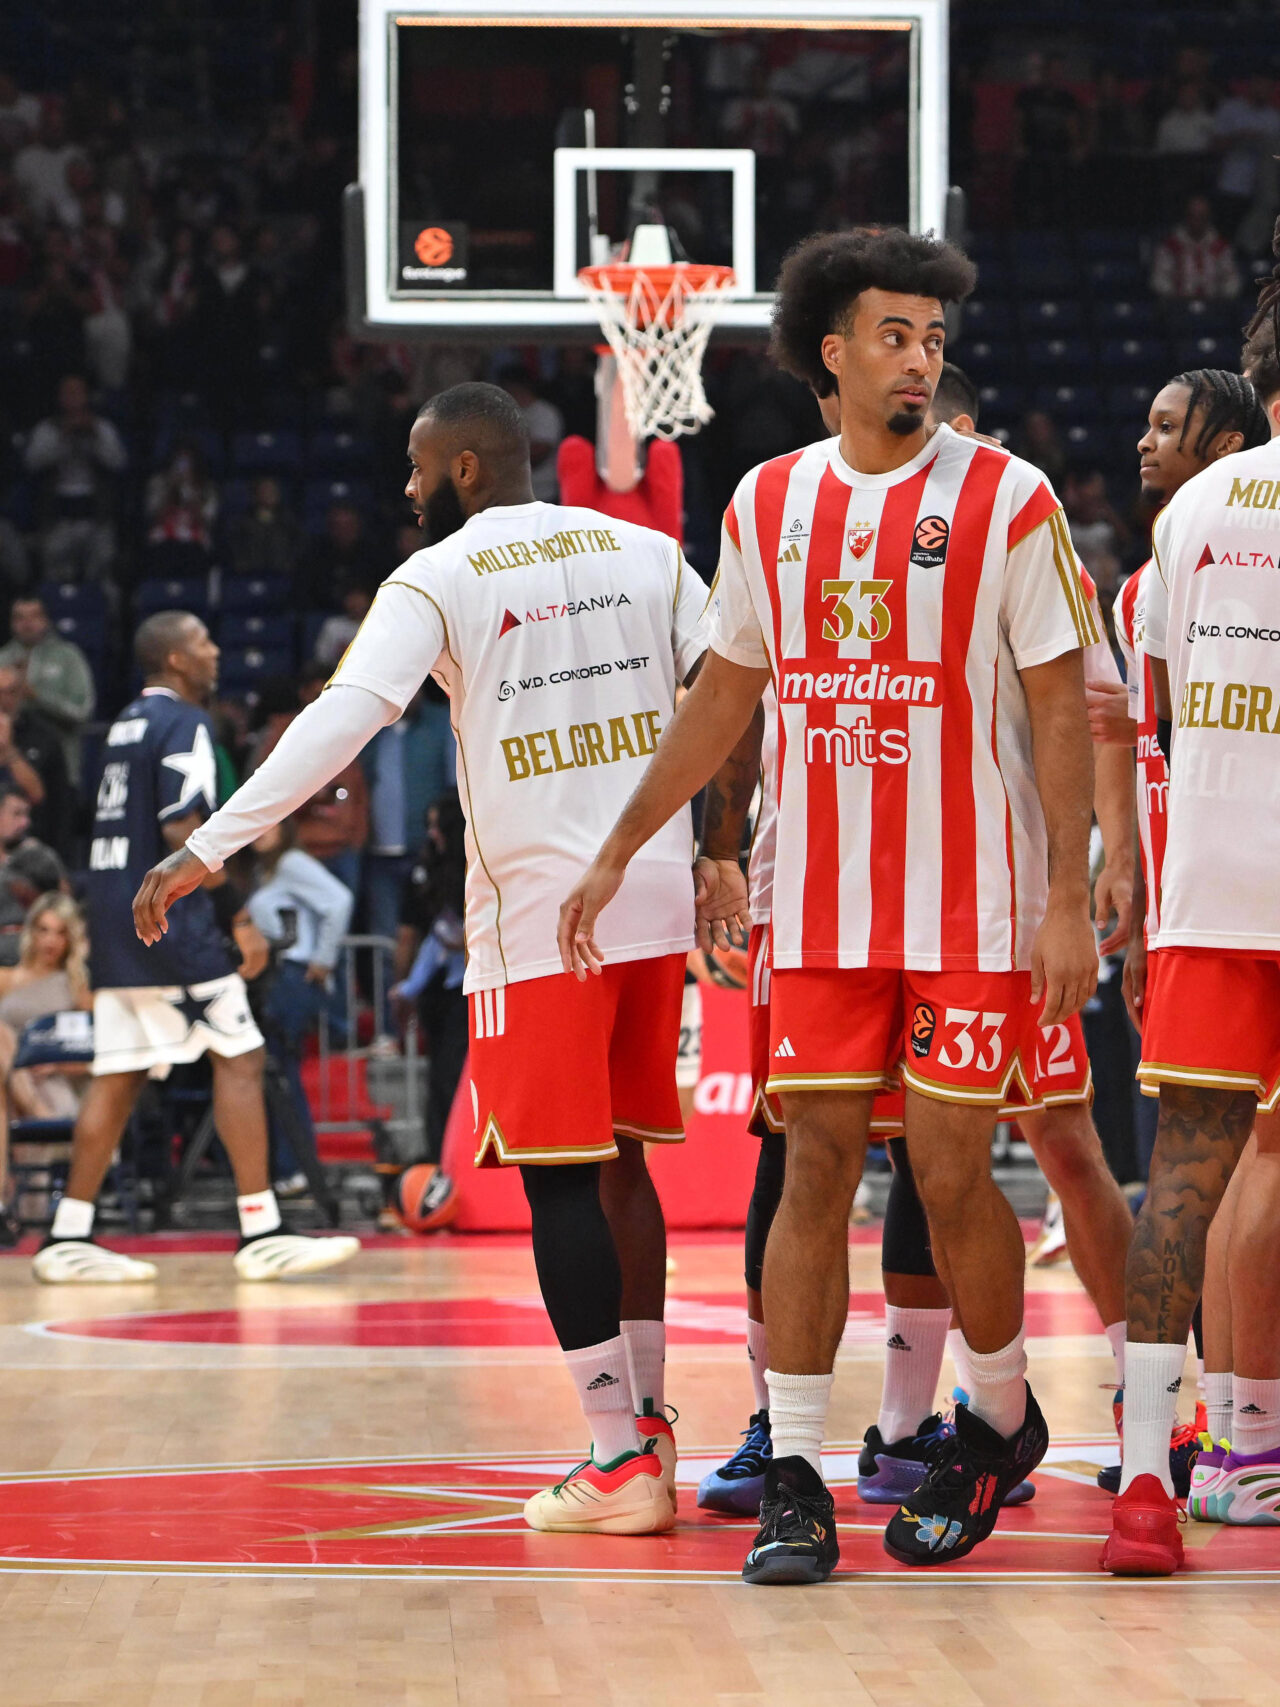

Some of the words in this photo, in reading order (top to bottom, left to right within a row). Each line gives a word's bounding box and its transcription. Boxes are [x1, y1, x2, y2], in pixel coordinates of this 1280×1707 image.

[821, 579, 893, 642] 33
[1198, 625, 1222, 637] W.D.
[518, 676, 547, 690] W.D.
[783, 664, 935, 702] meridian
[807, 719, 909, 765] mts
[937, 1007, 1008, 1072] 33
